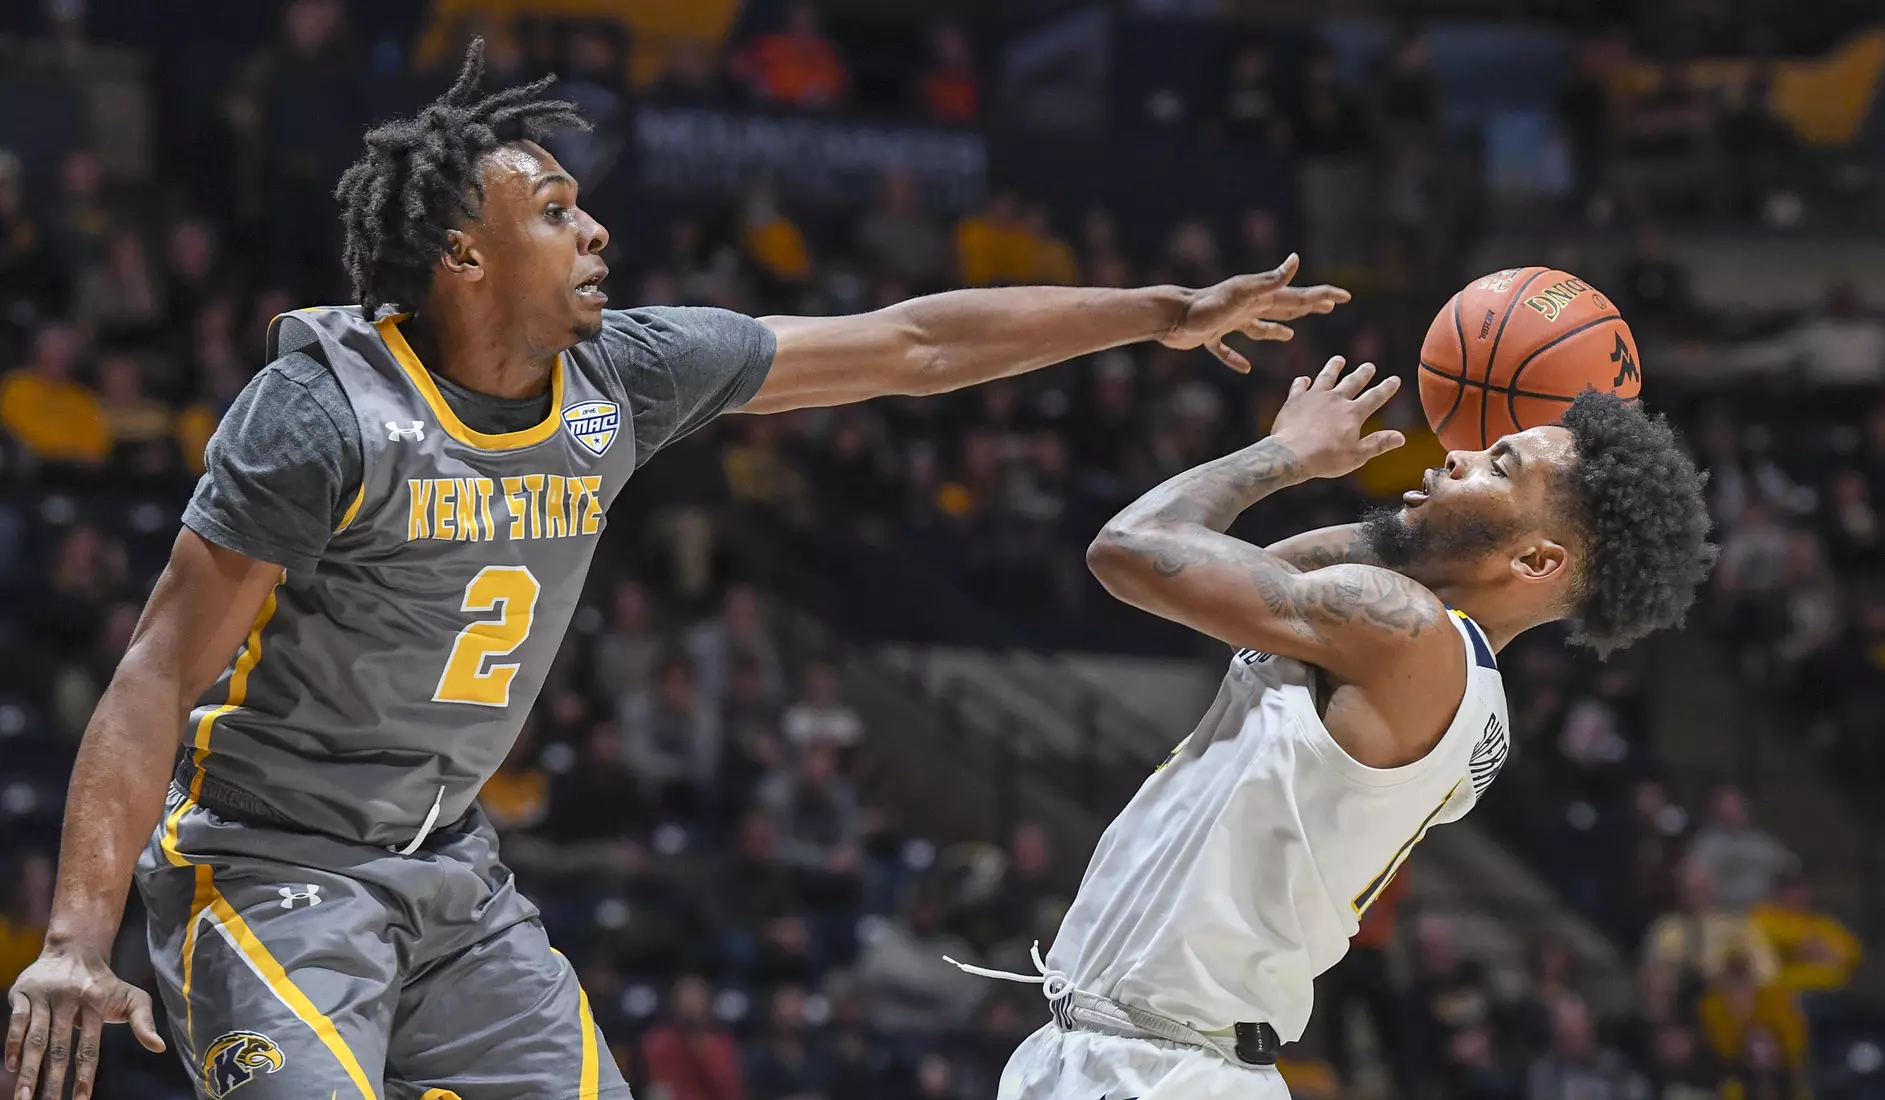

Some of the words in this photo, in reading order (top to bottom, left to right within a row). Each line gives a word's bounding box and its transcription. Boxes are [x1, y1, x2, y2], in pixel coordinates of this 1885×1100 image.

[1524, 278, 1593, 322] DING
[569, 414, 619, 435] MAC
[407, 477, 494, 541] KENT
[500, 474, 603, 540] STATE
[431, 565, 541, 707] 2
